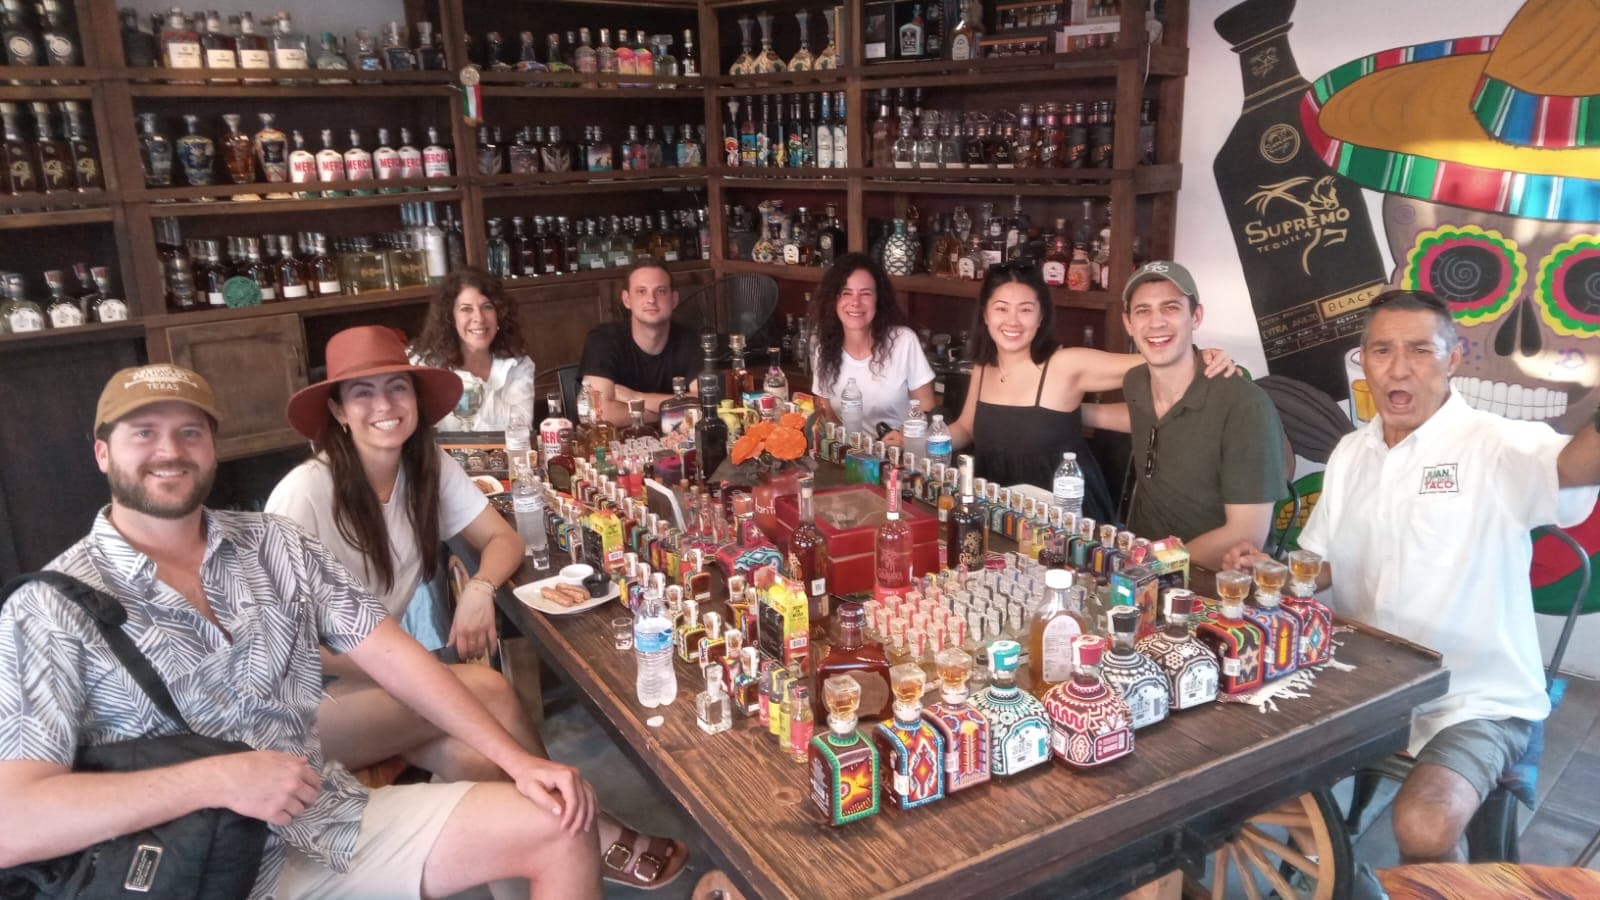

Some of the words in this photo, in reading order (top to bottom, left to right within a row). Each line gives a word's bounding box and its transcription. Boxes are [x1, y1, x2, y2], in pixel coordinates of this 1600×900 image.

[1245, 207, 1351, 245] SUPREMO
[1257, 231, 1312, 253] TEQUILA
[1327, 290, 1375, 314] BLACK
[147, 382, 180, 391] TEXAS
[1425, 469, 1450, 481] JUAN
[1424, 480, 1455, 490] TACO
